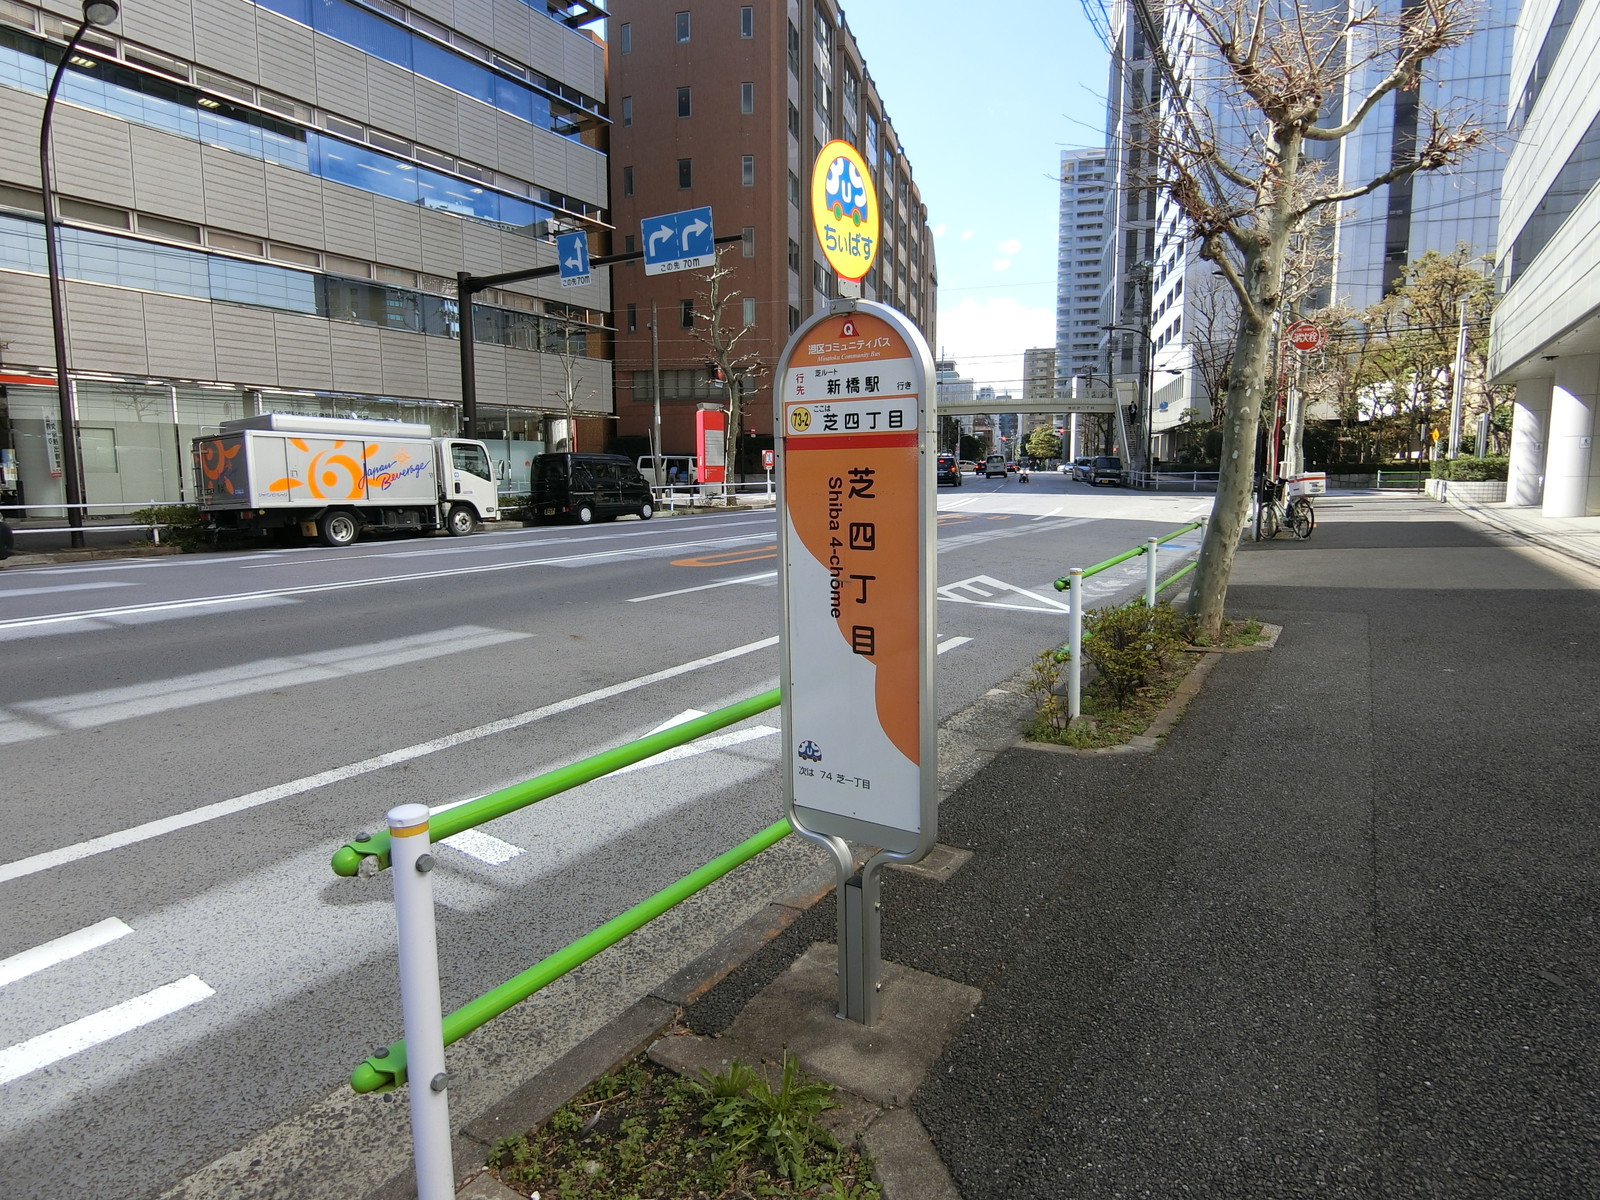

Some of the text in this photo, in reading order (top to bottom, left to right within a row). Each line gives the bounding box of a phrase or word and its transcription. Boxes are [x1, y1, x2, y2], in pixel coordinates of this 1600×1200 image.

[660, 257, 700, 272] この先 70m
[562, 275, 591, 287] この先 70m
[843, 323, 853, 335] Q
[808, 337, 891, 355] 港区コミュニティバス
[815, 369, 838, 377] 芝ルート
[796, 373, 805, 395] 行先
[827, 376, 911, 395] 新橋駅 行き
[792, 413, 809, 427] 73-2
[823, 410, 903, 431] 芝四丁目
[358, 460, 431, 491] Japan Beverage
[829, 476, 843, 531] Shiba
[848, 467, 876, 656] 芝四丁目
[799, 766, 870, 789] 次は 74 芝一丁目
